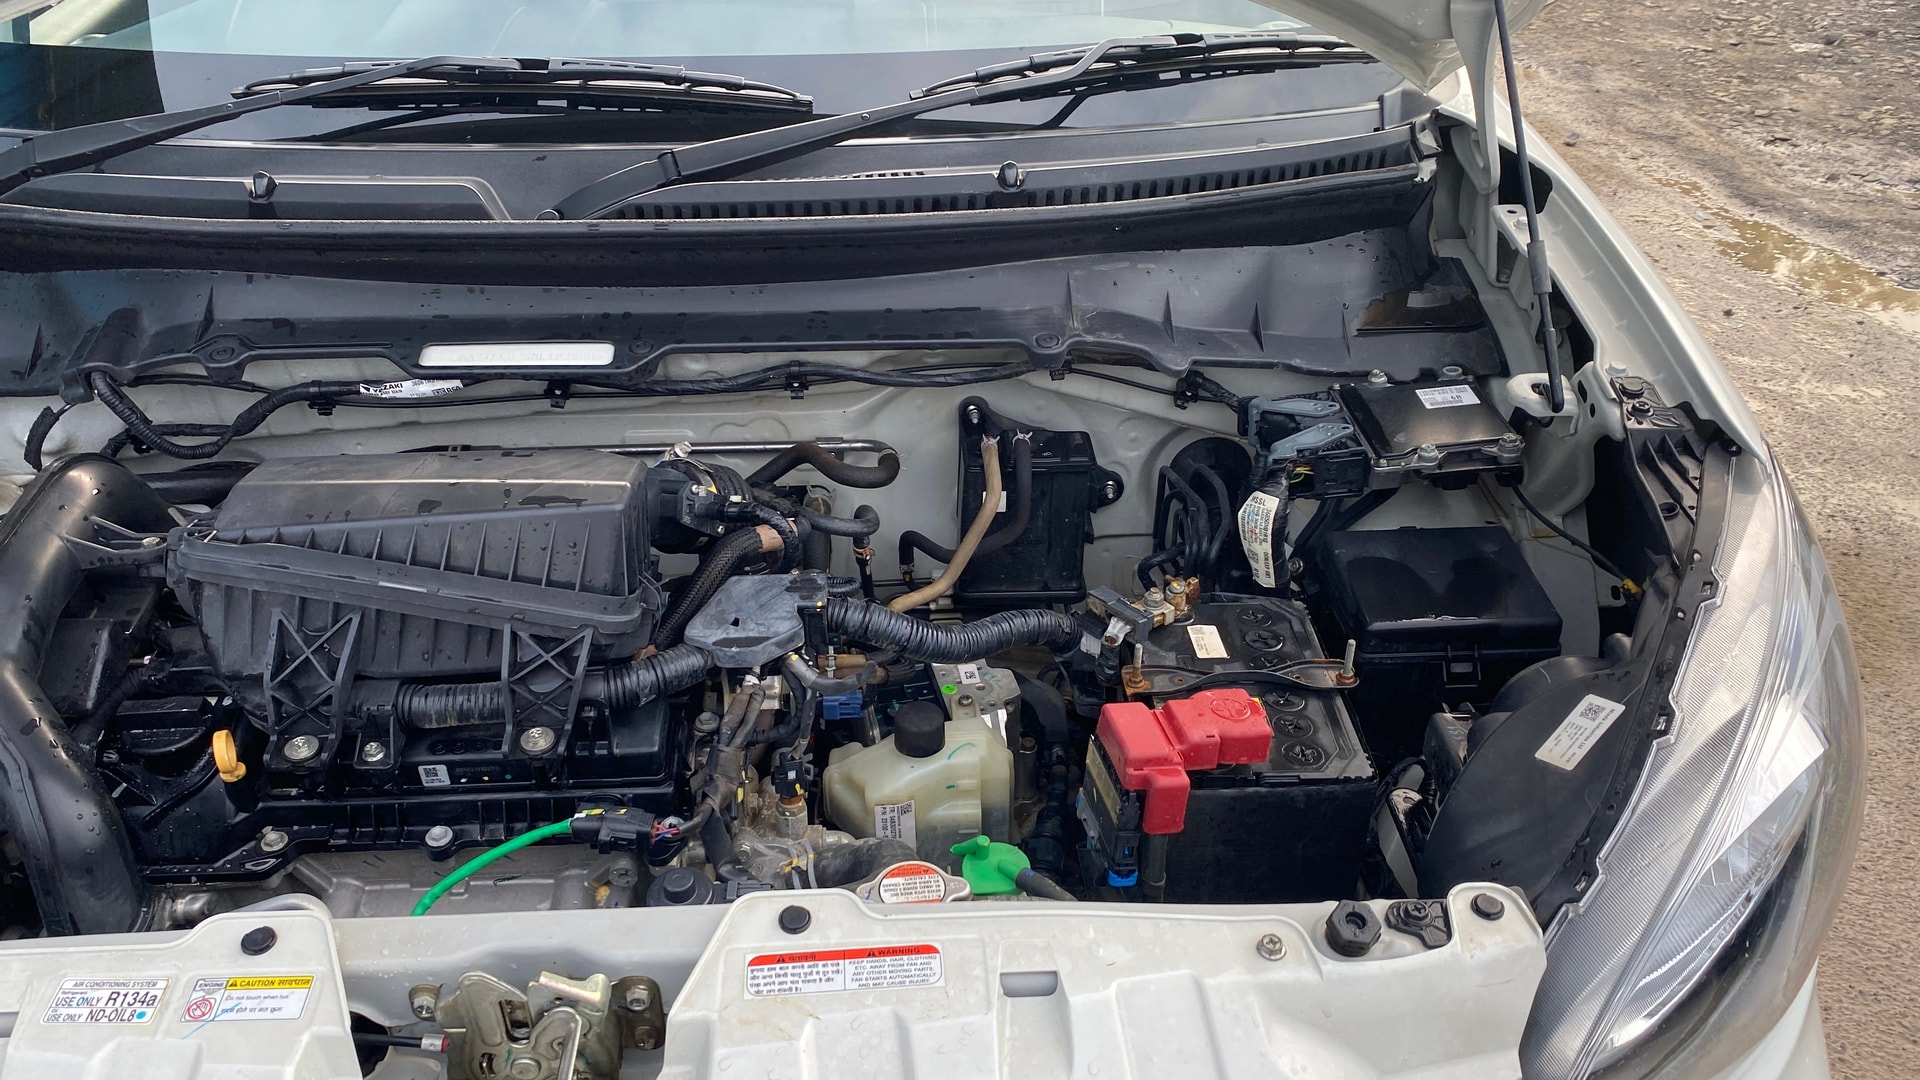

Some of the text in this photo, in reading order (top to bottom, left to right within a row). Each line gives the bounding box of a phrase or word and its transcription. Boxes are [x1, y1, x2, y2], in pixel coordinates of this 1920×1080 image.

[878, 947, 920, 956] WARNING
[55, 991, 158, 1007] USE ONLY R134a
[85, 1009, 137, 1022] ND-OIL8
